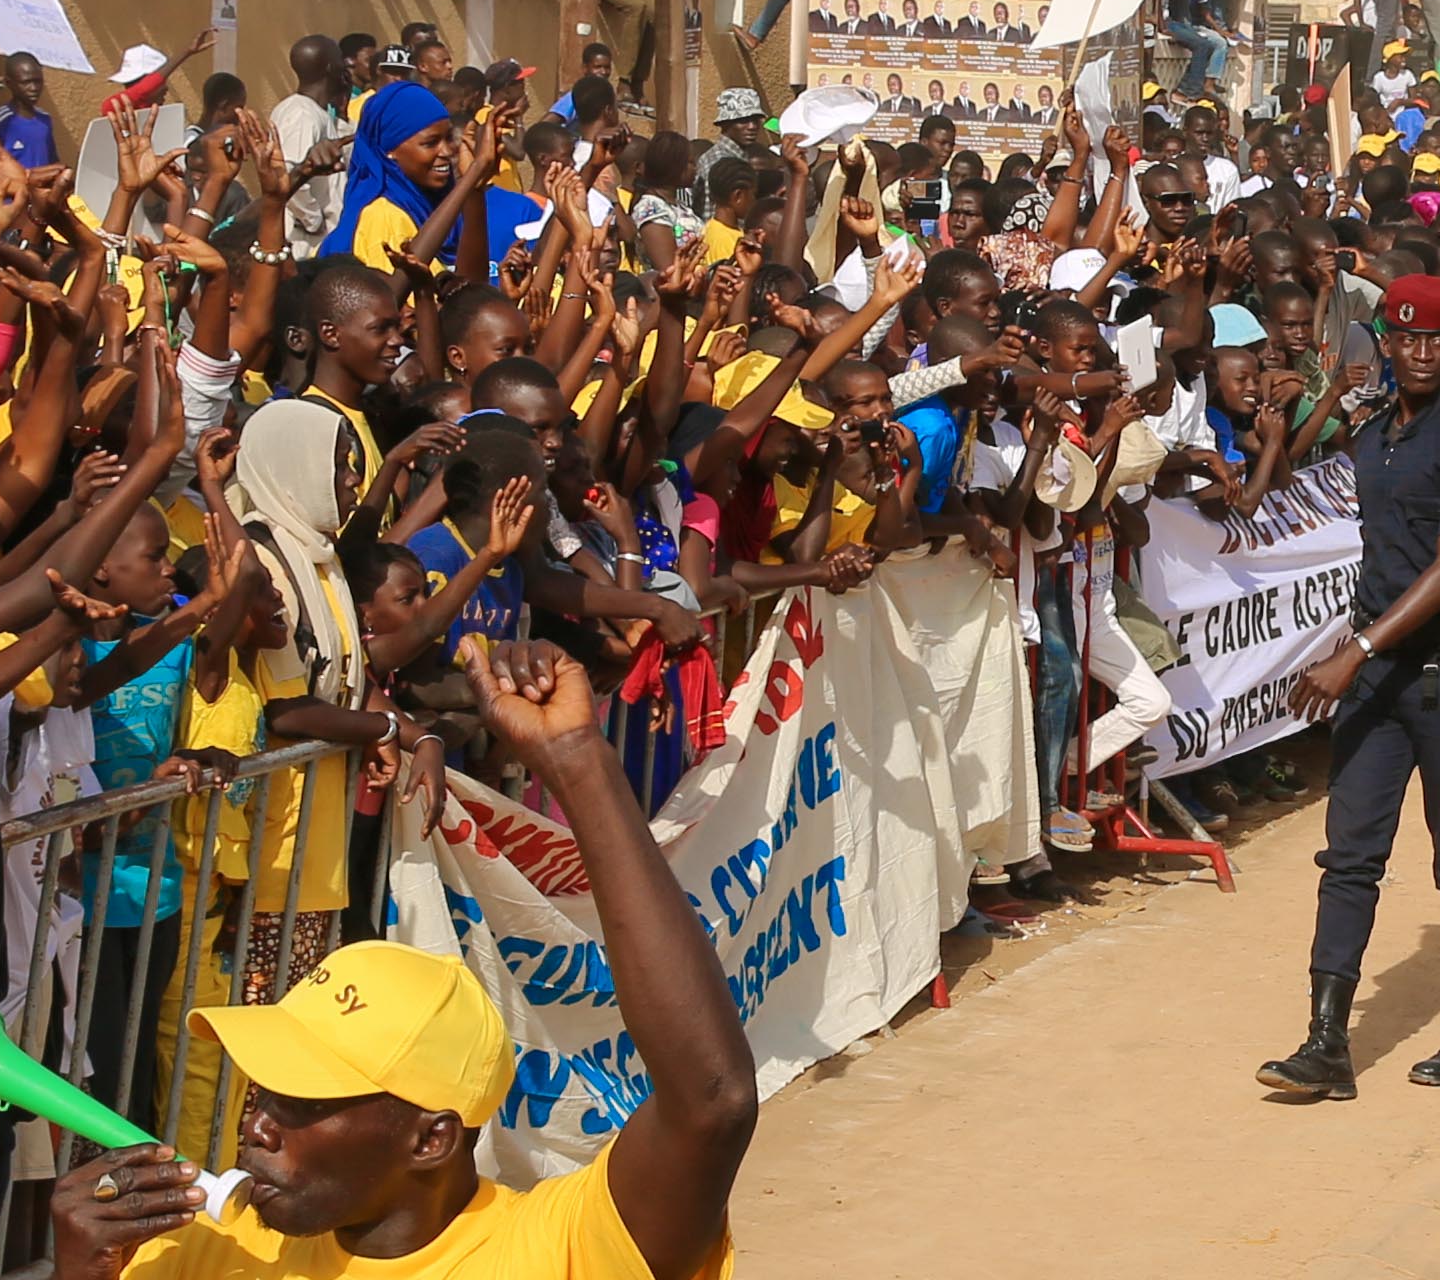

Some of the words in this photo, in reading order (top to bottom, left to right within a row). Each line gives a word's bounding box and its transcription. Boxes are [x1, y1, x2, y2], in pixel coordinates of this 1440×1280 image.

[386, 49, 410, 64] NY
[1204, 585, 1283, 658] CADRE
[1291, 558, 1363, 629] ACTEU
[1167, 706, 1210, 763] DU
[334, 984, 368, 1016] Sy
